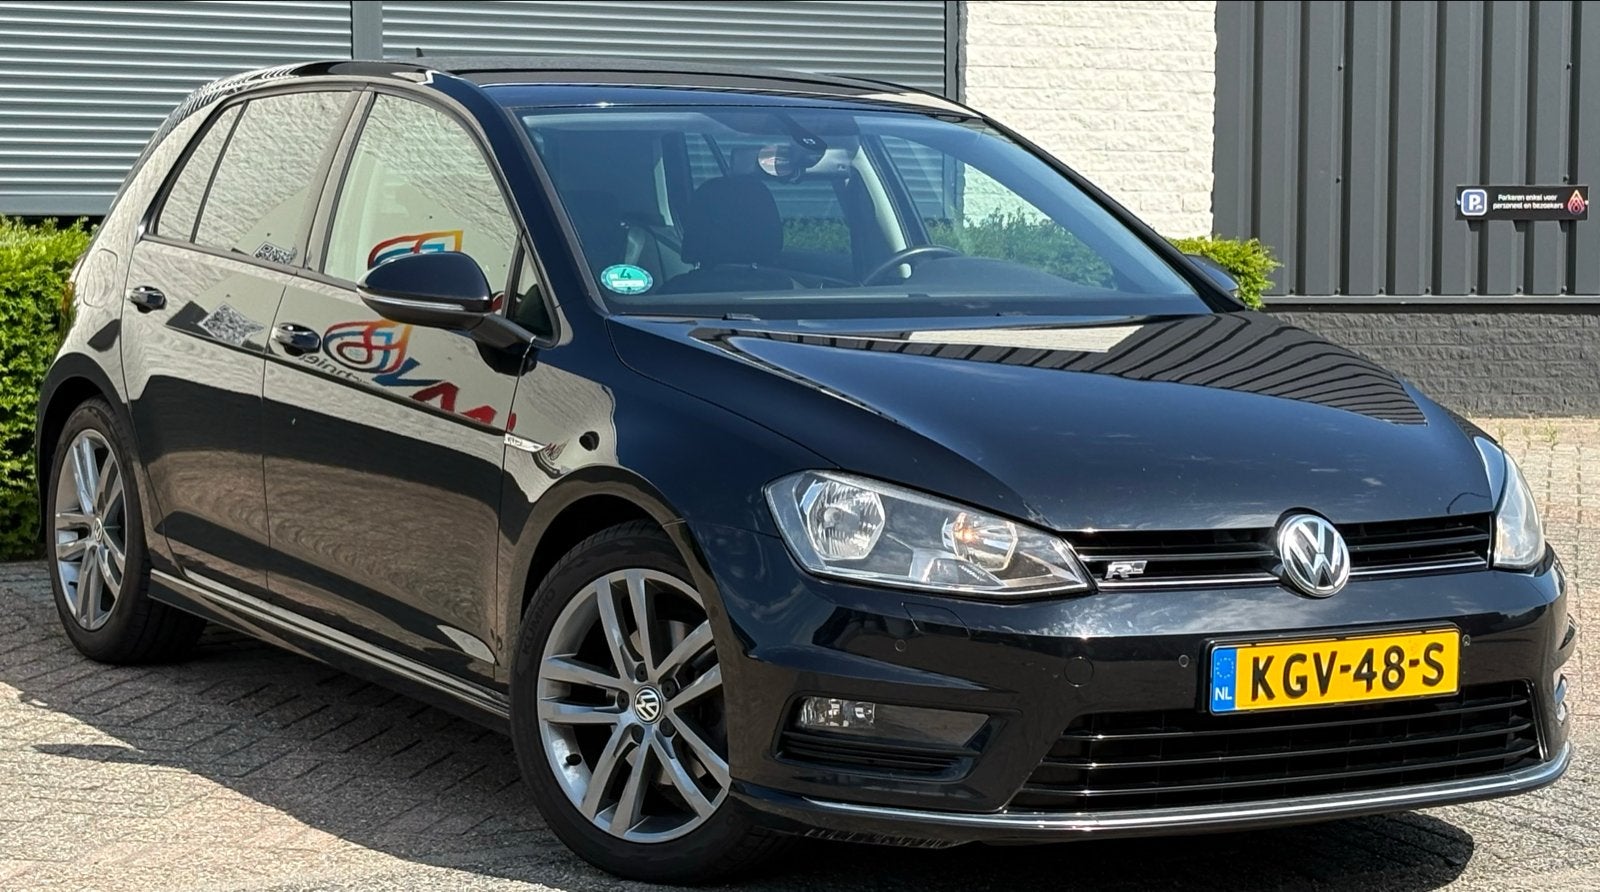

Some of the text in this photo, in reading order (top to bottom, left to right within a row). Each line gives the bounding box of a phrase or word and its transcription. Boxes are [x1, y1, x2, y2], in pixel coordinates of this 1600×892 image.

[1469, 194, 1480, 211] P
[1492, 202, 1523, 210] personeel
[620, 268, 632, 279] 4
[522, 588, 556, 655] KUMHO
[1251, 642, 1445, 701] KGV-48-S
[1214, 686, 1233, 701] NL
